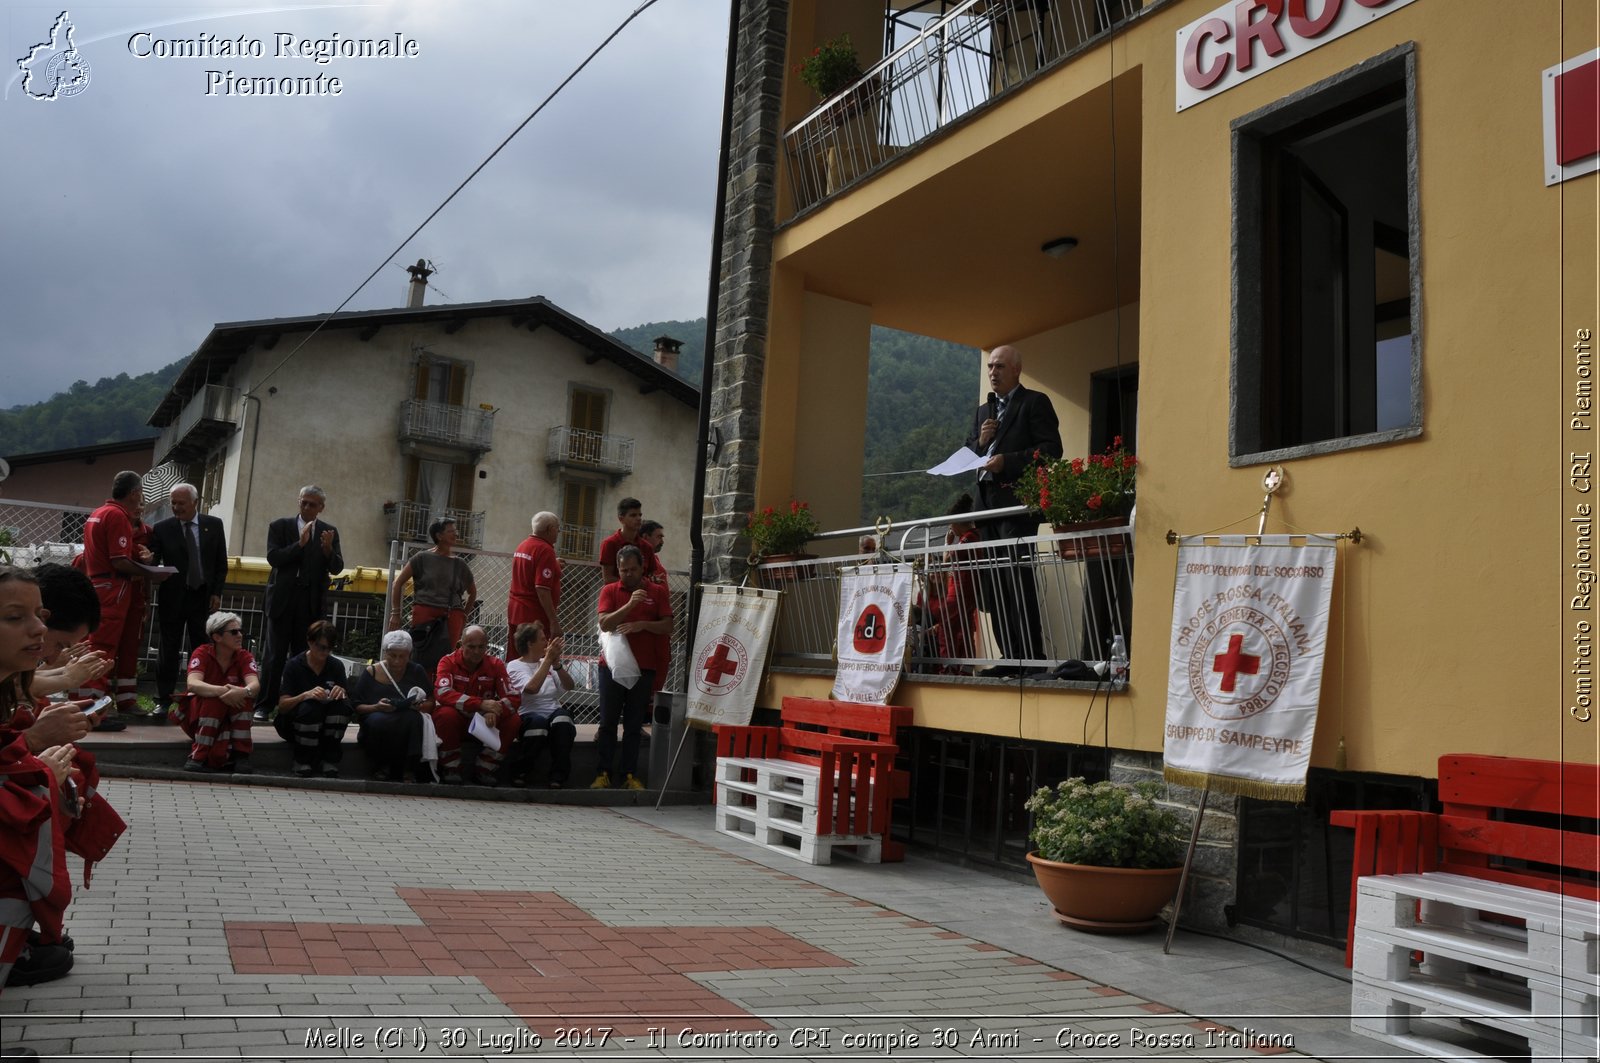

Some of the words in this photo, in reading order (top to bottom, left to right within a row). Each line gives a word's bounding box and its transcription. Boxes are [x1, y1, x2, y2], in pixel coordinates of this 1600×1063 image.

[1183, 0, 1393, 91] CRO
[1186, 563, 1209, 575] CORPO
[1255, 565, 1271, 577] DEL
[1274, 566, 1324, 578] SOCCORSO
[1178, 599, 1214, 647] CROCE
[1216, 584, 1263, 606] ROSSA
[1267, 593, 1312, 656] ITALIANA
[1206, 622, 1219, 635] DI
[1219, 609, 1265, 627] GINEVRA
[1266, 643, 1288, 696] AGOSTO
[1239, 696, 1267, 715] 1864
[1167, 724, 1204, 741] GRUPPO
[1206, 727, 1216, 741] DI
[1218, 729, 1304, 755] SAMPEYRE
